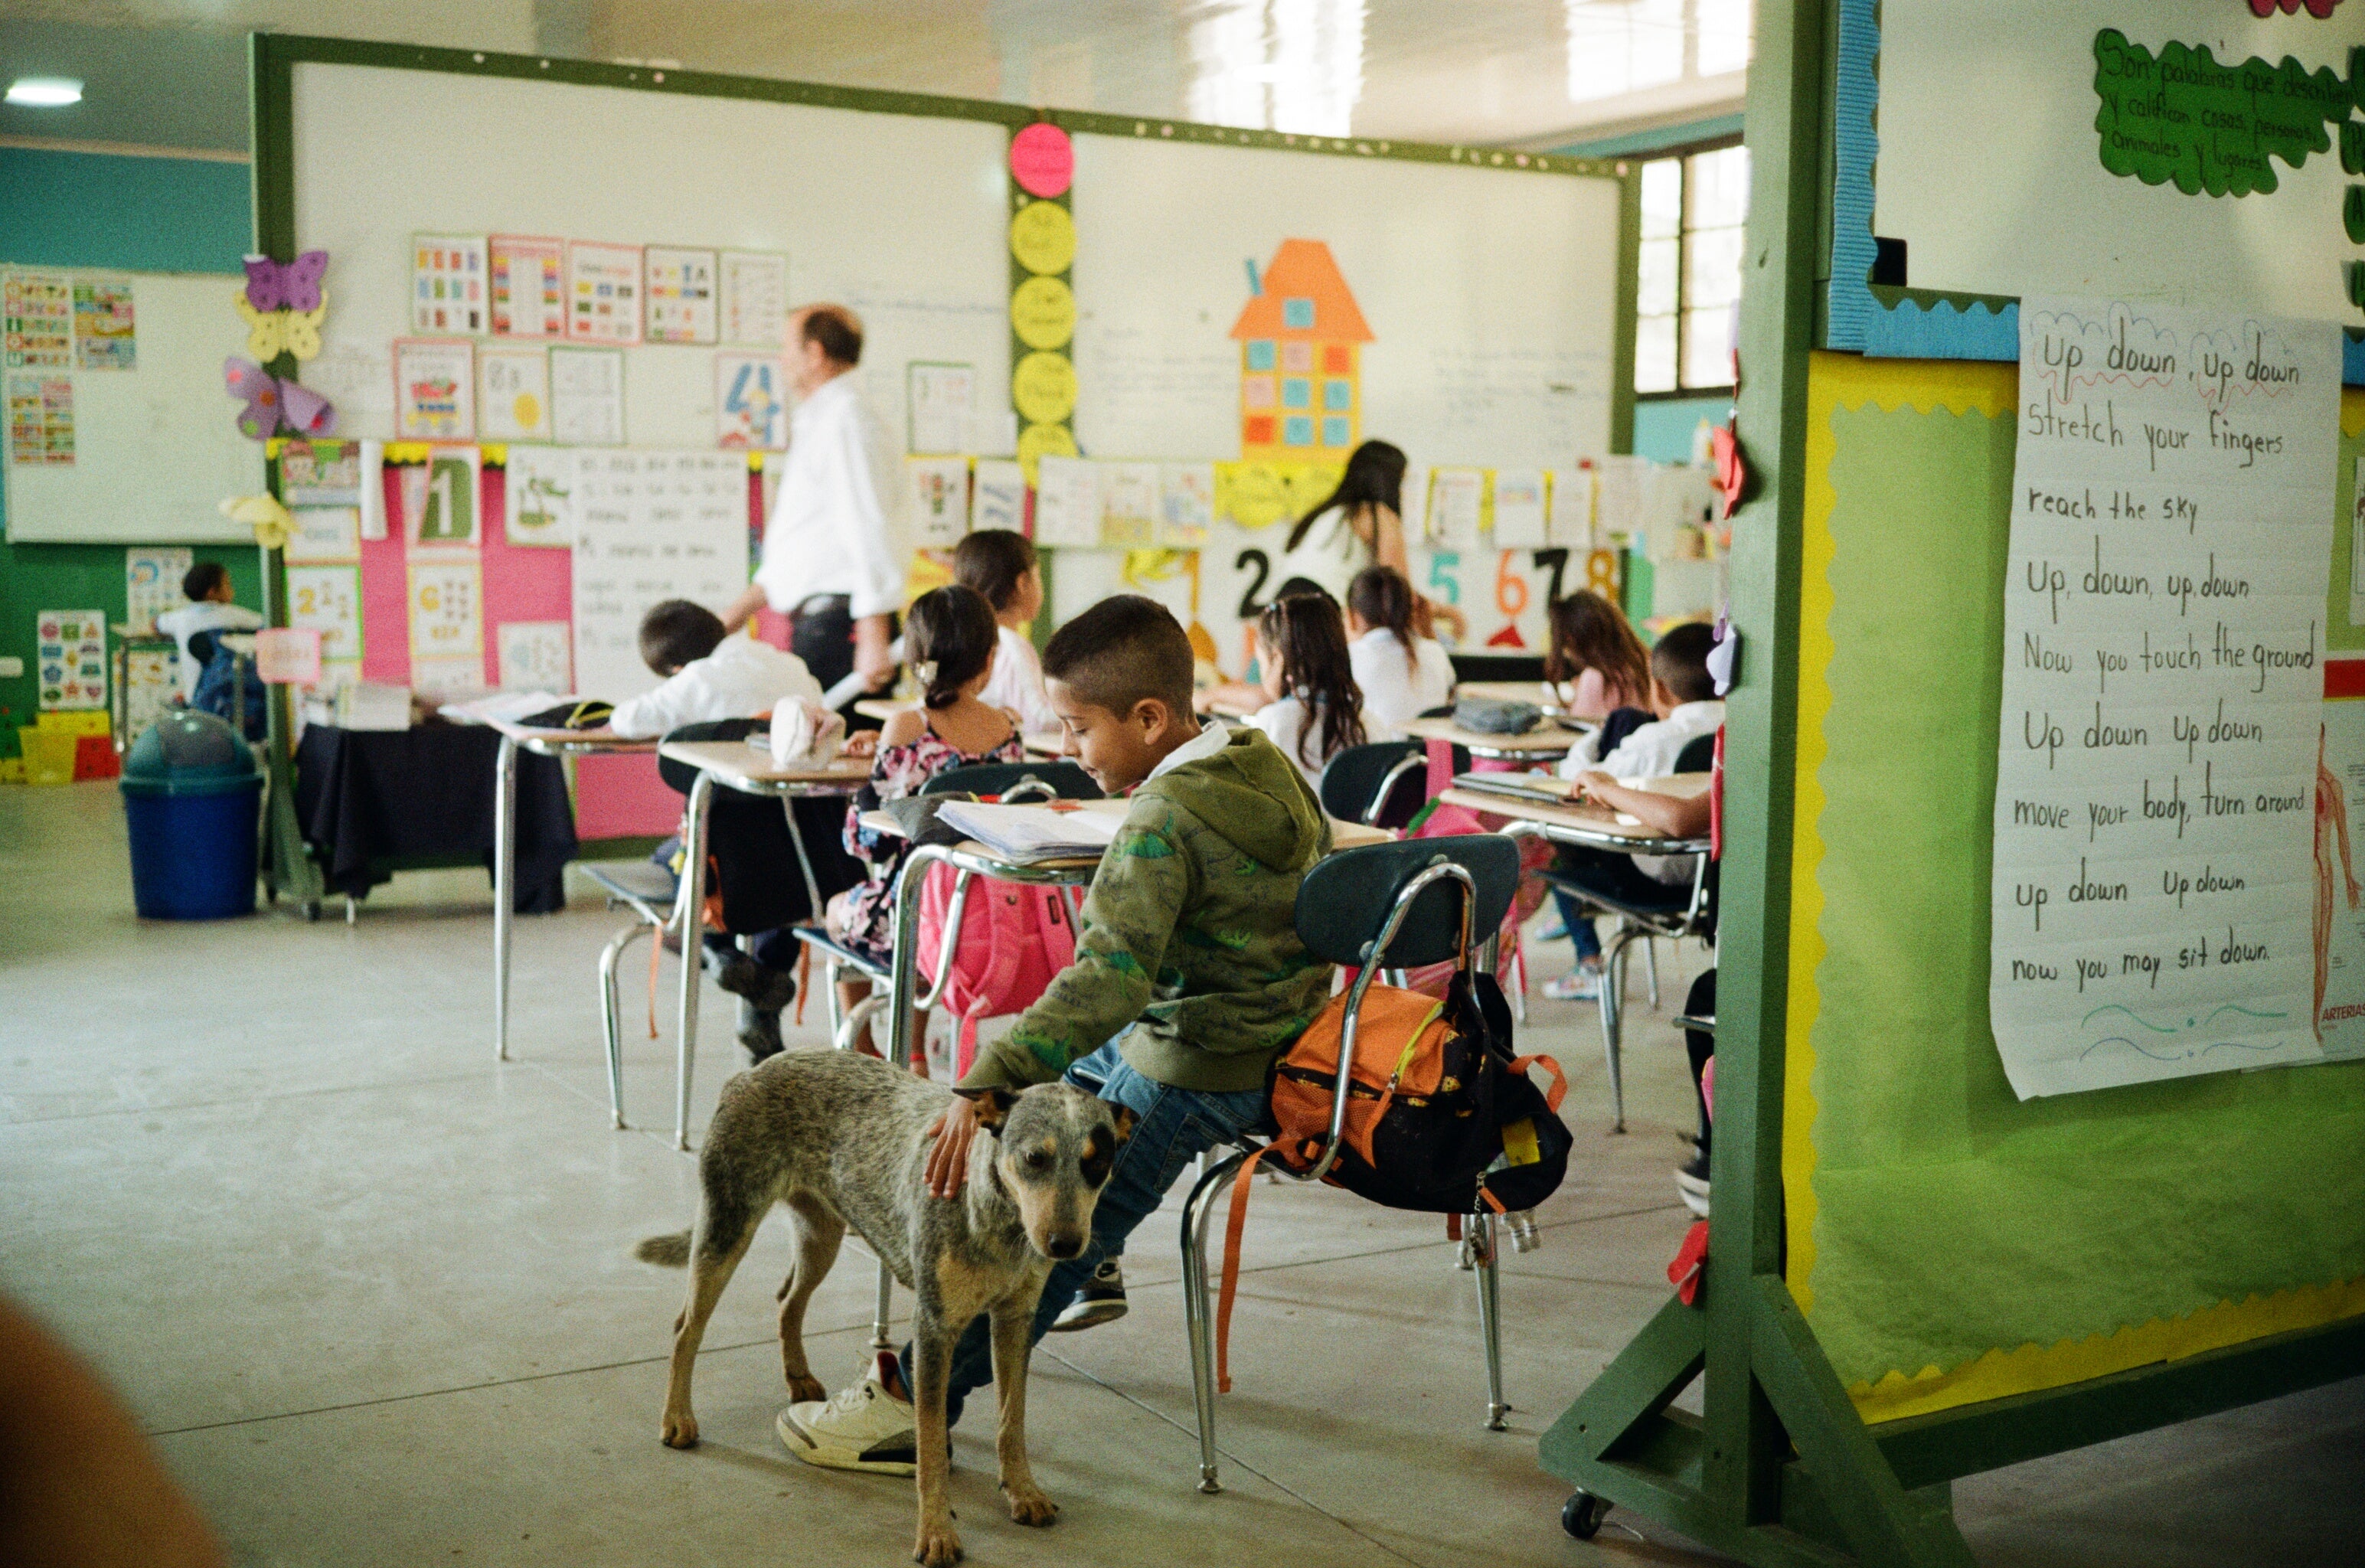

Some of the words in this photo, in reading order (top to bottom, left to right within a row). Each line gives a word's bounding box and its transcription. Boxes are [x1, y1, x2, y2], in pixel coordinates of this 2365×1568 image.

[2102, 40, 2151, 80] Son
[2045, 335, 2083, 402] Up
[2246, 331, 2299, 385] down
[2145, 423, 2190, 472] your
[2210, 409, 2283, 469] fingers
[430, 468, 455, 535] 1
[2029, 487, 2096, 520] reach
[2109, 490, 2146, 521] the
[2163, 496, 2197, 536] sky
[1235, 547, 1271, 620] 2
[1429, 551, 1461, 606] 5
[1495, 546, 1529, 618] 6
[1534, 547, 1570, 609] 7
[1586, 547, 1620, 602] 8
[2083, 534, 2154, 600] down,
[2201, 552, 2249, 598] down
[2024, 632, 2073, 674] Now
[2097, 649, 2128, 694] you
[2140, 632, 2201, 673] touch
[2212, 621, 2245, 668] the
[2252, 619, 2315, 693] ground
[2025, 711, 2064, 770] Up
[2084, 701, 2148, 749] down
[2208, 697, 2262, 744] down
[2014, 799, 2069, 829] move
[2089, 802, 2128, 843] your
[2144, 775, 2191, 840] body,
[2200, 760, 2245, 816] turn
[2256, 786, 2305, 812] around
[2069, 856, 2128, 903] down
[2197, 865, 2245, 893] down
[2012, 959, 2058, 982] now
[2076, 957, 2107, 994] you
[2123, 953, 2161, 990] may
[2178, 936, 2208, 969] sit
[2220, 925, 2271, 965] down.
